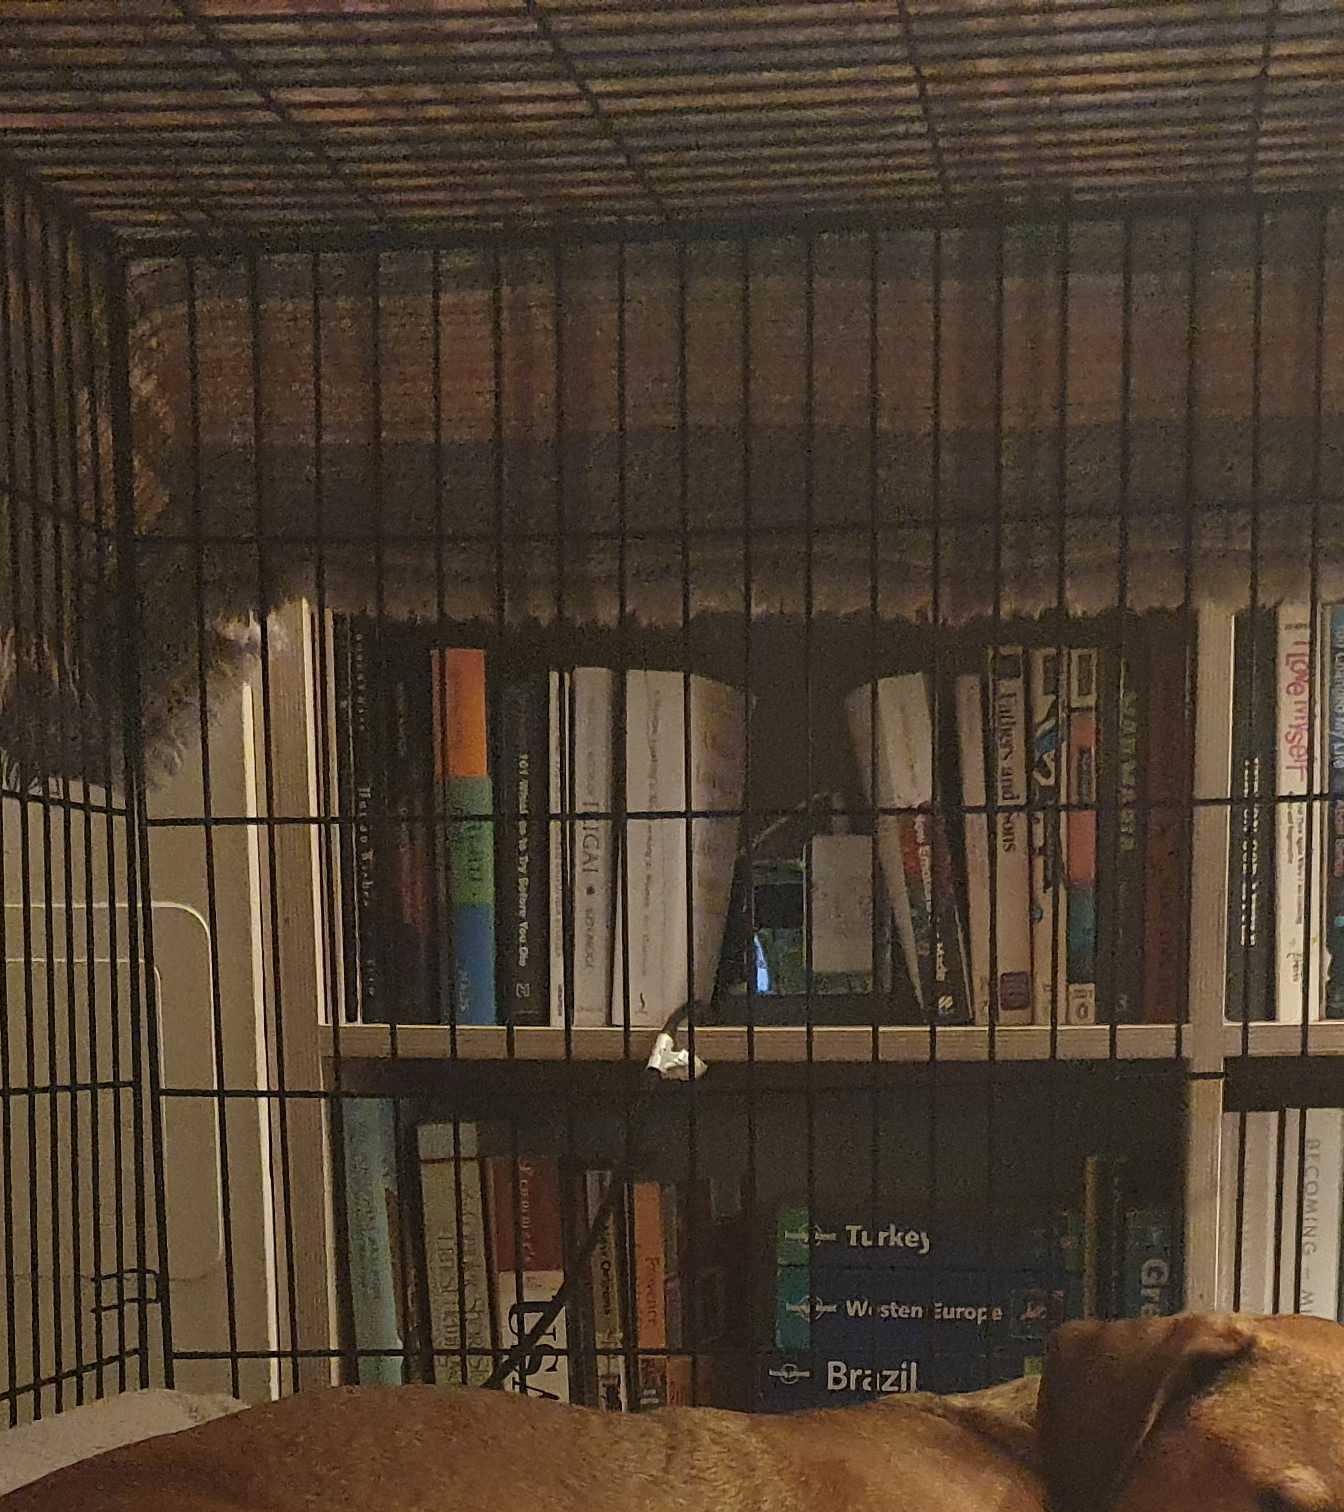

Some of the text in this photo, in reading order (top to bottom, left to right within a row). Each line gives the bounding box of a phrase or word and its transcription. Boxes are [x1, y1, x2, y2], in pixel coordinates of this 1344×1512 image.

[1002, 766, 1021, 801] and
[582, 801, 600, 873] IIGAI
[1303, 1138, 1321, 1256] BECOMING
[845, 1223, 930, 1255] Turkey
[933, 1301, 1003, 1325] Europe
[827, 1360, 918, 1392] Brazil
